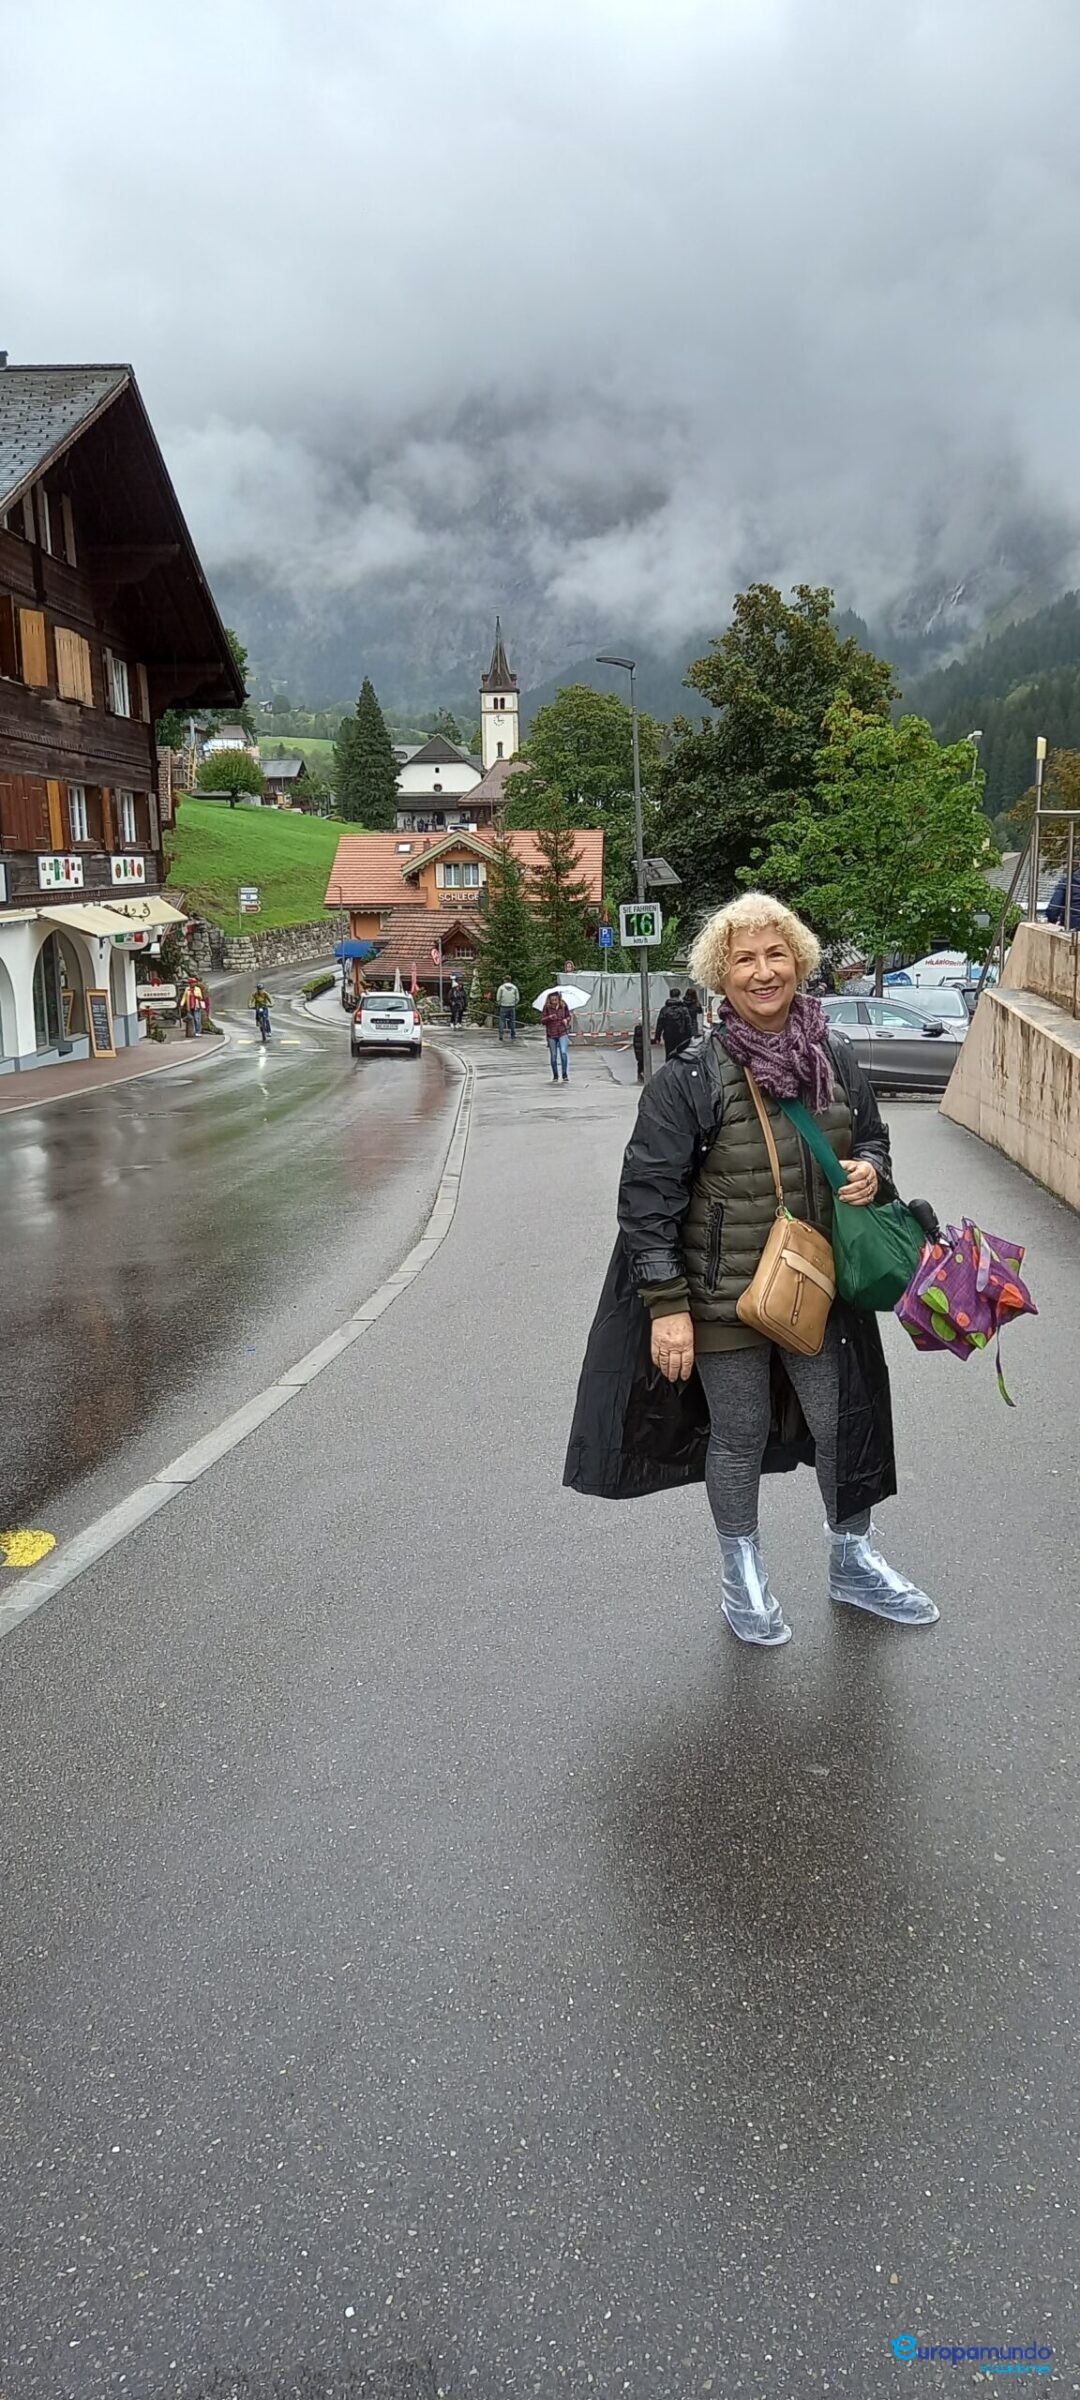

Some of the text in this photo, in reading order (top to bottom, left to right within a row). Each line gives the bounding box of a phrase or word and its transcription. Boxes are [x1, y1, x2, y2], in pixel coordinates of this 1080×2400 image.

[622, 904, 657, 914] SIE FAHREN
[630, 913, 652, 936] 16
